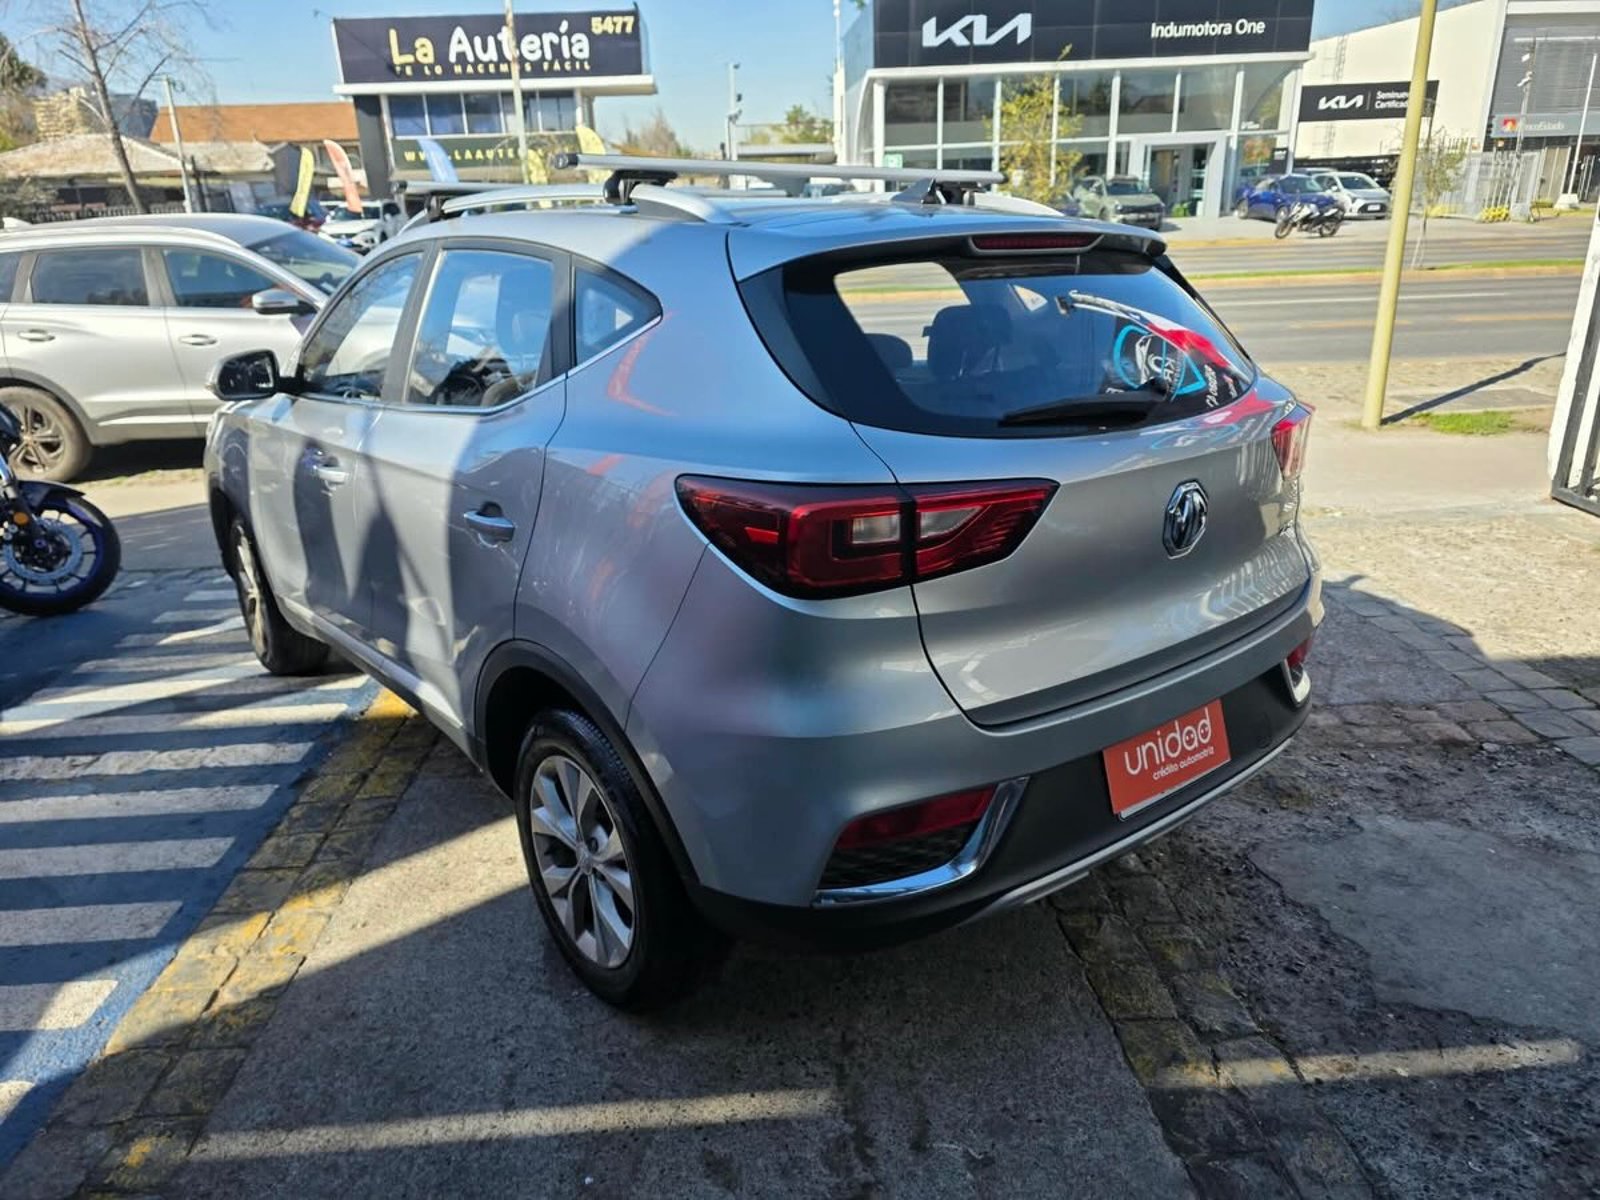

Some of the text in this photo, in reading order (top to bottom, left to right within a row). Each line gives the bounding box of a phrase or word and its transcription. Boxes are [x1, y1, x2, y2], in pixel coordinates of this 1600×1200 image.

[591, 15, 635, 35] 5477
[922, 12, 1032, 48] KIA
[1151, 18, 1266, 38] Indumotora One
[388, 19, 590, 65] La Autería
[453, 62, 532, 74] HACEMS
[1124, 707, 1212, 775] unidad
